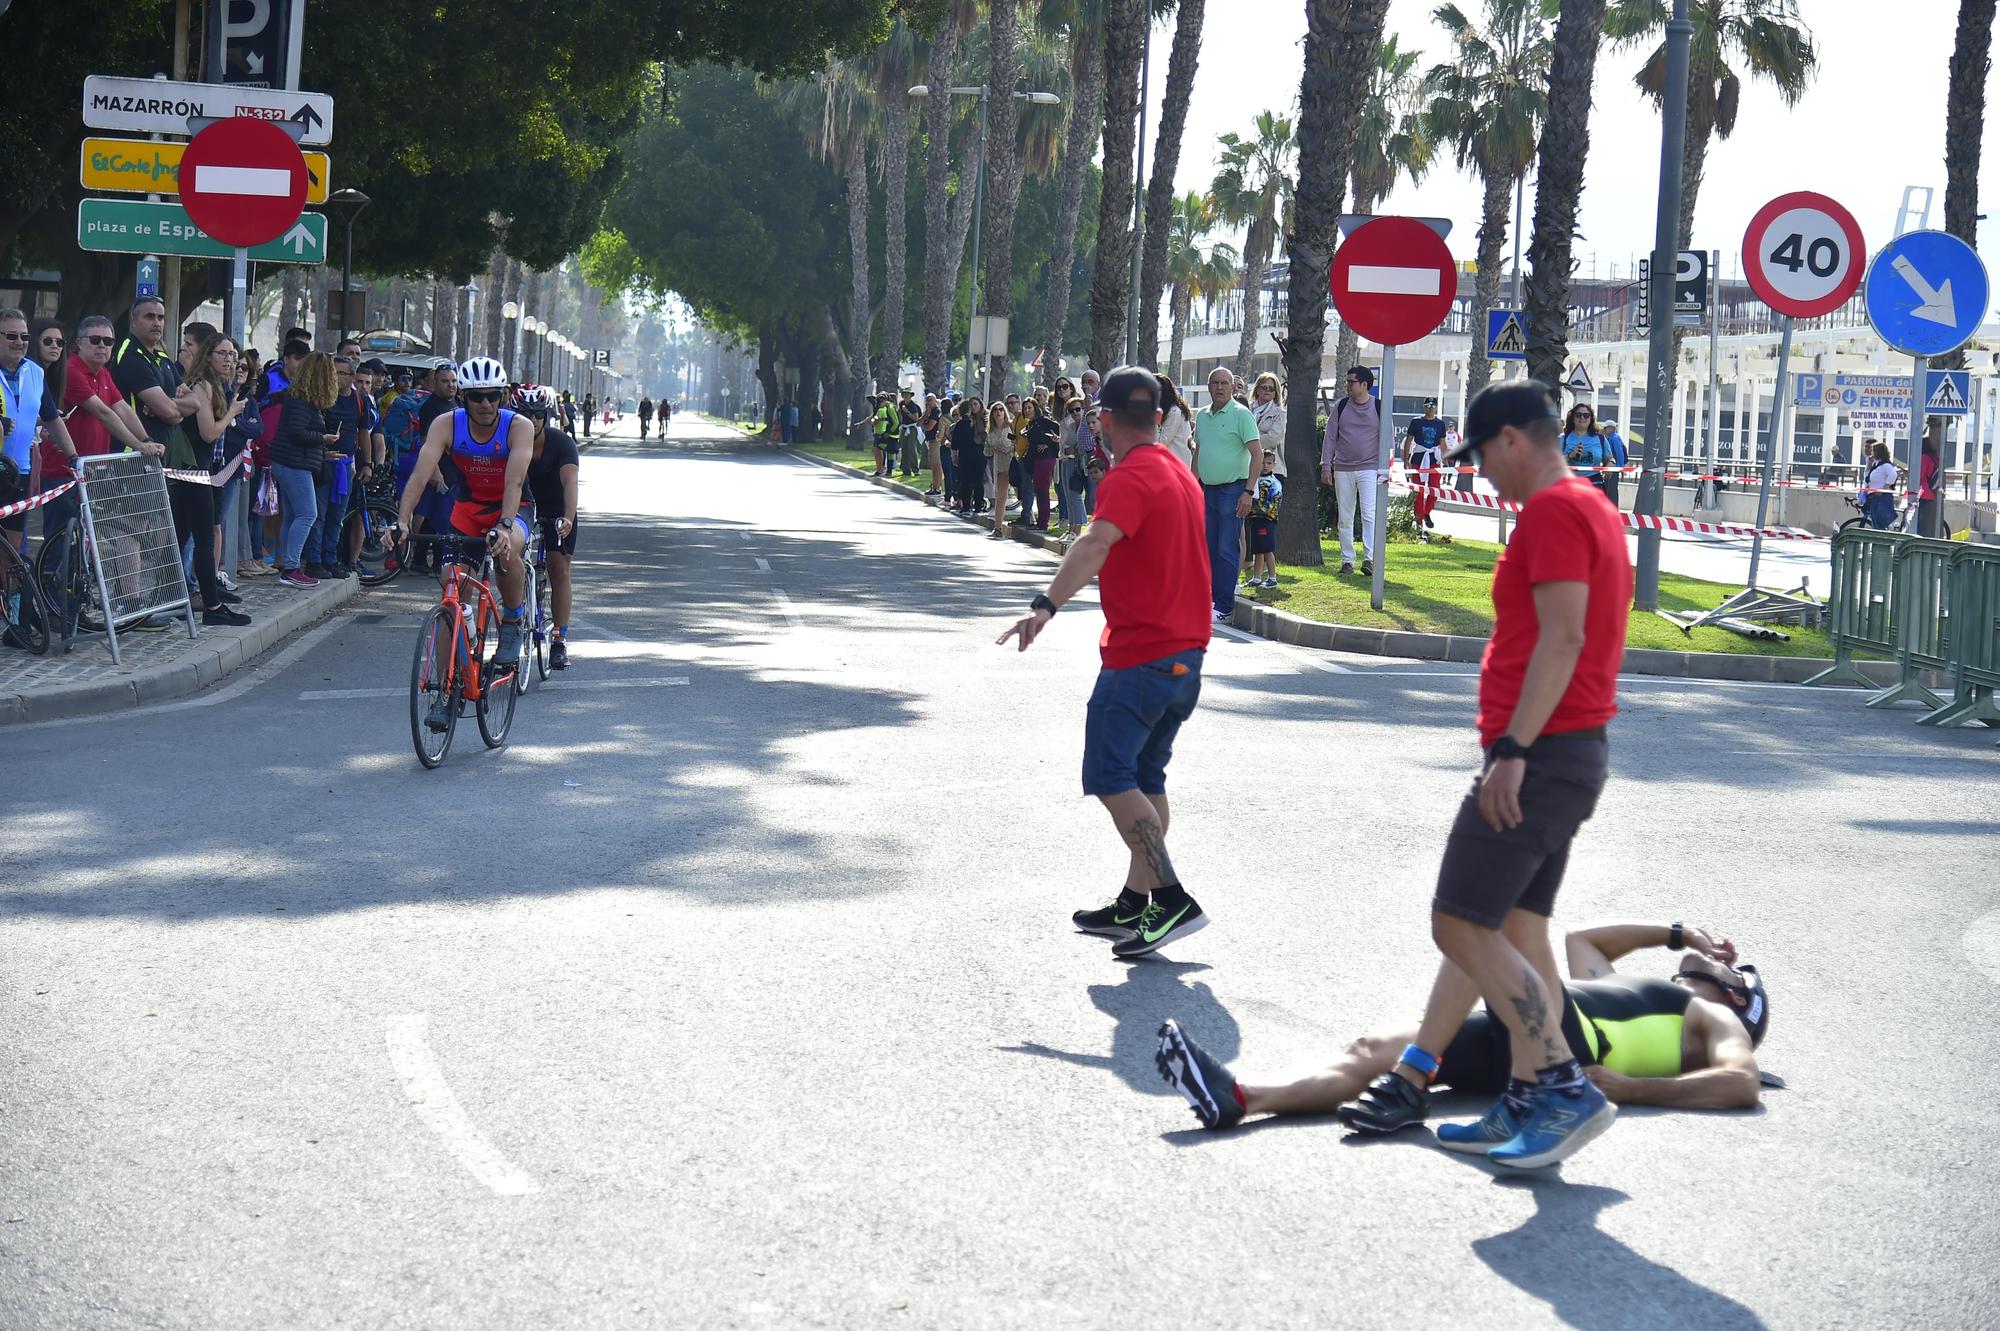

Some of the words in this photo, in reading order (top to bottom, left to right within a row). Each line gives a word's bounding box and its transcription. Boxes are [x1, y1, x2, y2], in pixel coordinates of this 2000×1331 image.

[220, 0, 270, 74] P
[93, 94, 203, 117] MAZARRÓN
[237, 107, 284, 120] N-332
[110, 154, 150, 174] Corte
[88, 220, 127, 233] plaza
[134, 223, 152, 235] de
[1770, 233, 1840, 278] 40
[596, 350, 607, 363] P
[1803, 376, 1818, 399] P
[1844, 376, 1893, 386] PARKING
[1863, 387, 1895, 396] Abierto
[1850, 411, 1878, 420] ALTURA
[1864, 421, 1876, 429] 190
[473, 455, 491, 466] FRAN
